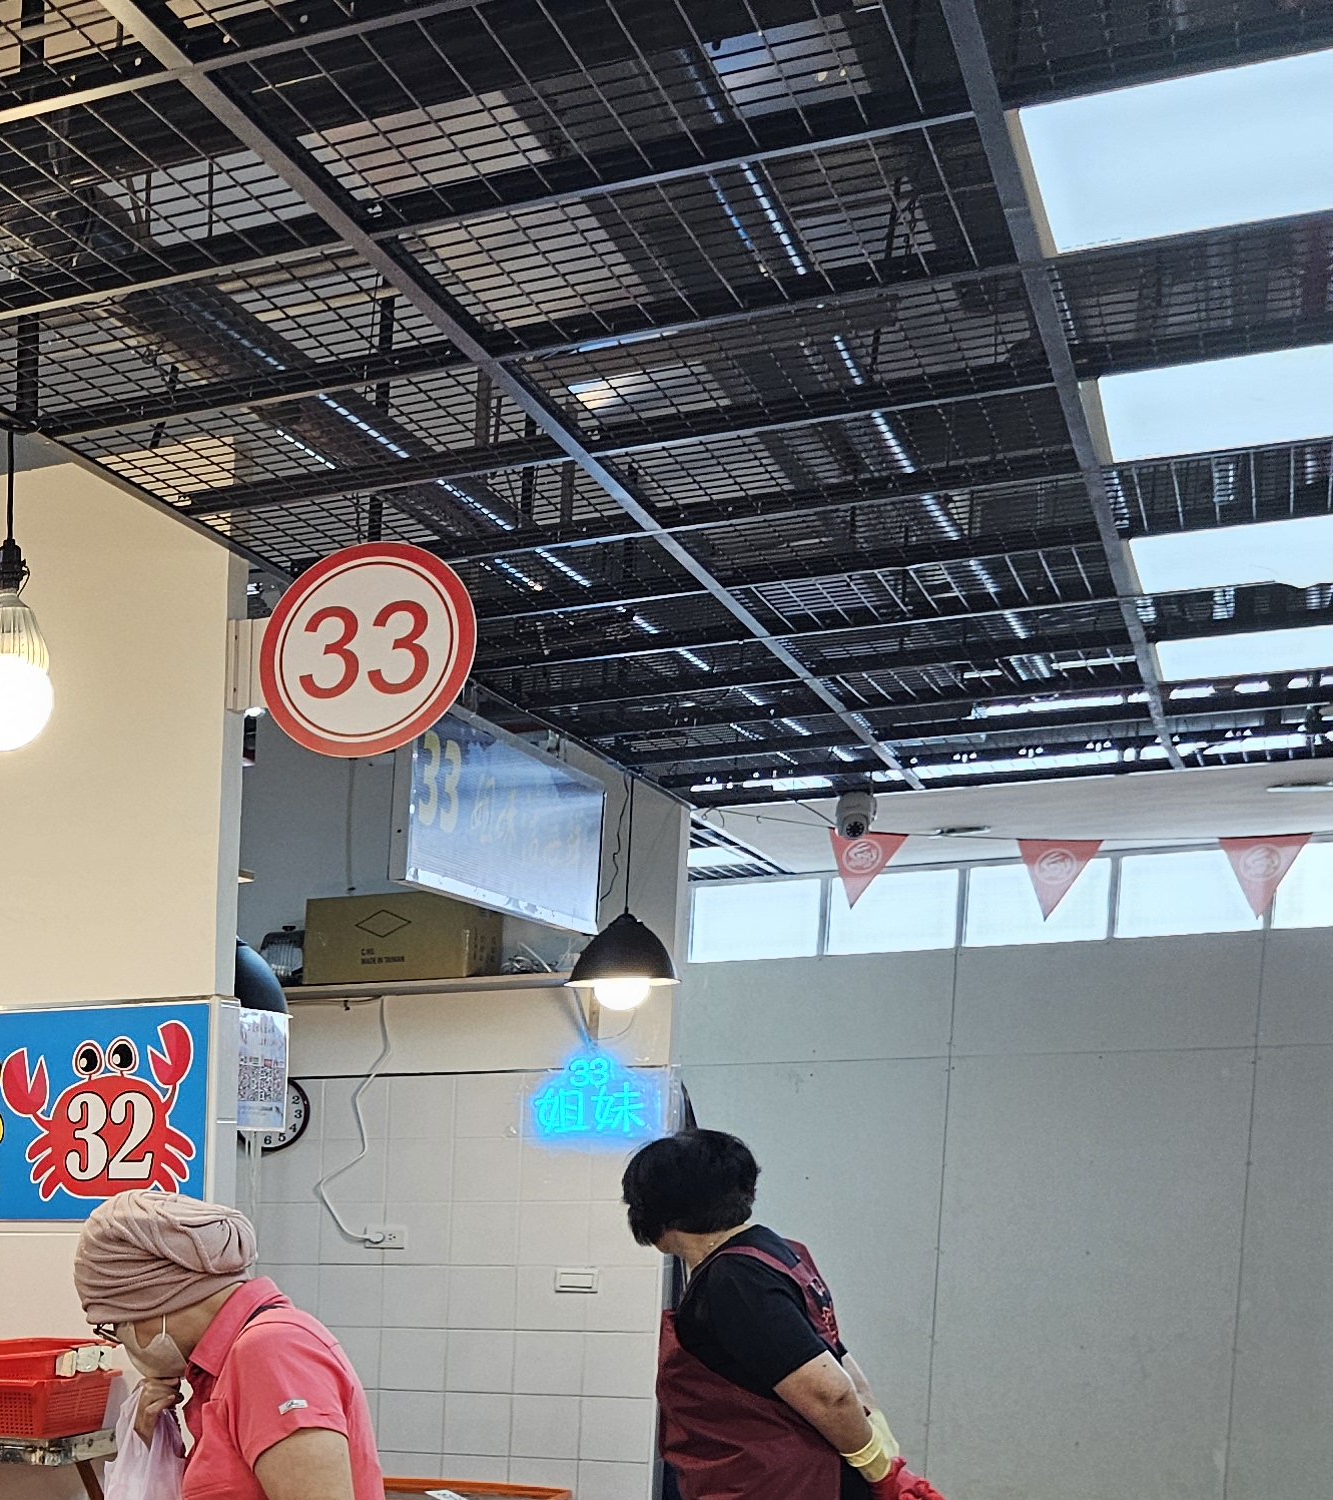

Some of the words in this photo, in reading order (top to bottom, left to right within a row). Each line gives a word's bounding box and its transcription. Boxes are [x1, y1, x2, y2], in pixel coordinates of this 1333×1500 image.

[299, 599, 430, 700] 33
[417, 731, 462, 834] 33
[569, 1057, 610, 1088] 33
[291, 1095, 301, 1105] 2
[534, 1081, 646, 1133] 姐妹
[294, 1109, 303, 1119] 3
[65, 1090, 155, 1181] 32
[278, 1133, 286, 1142] 5
[288, 1123, 297, 1133] 4
[263, 1135, 272, 1145] 6
